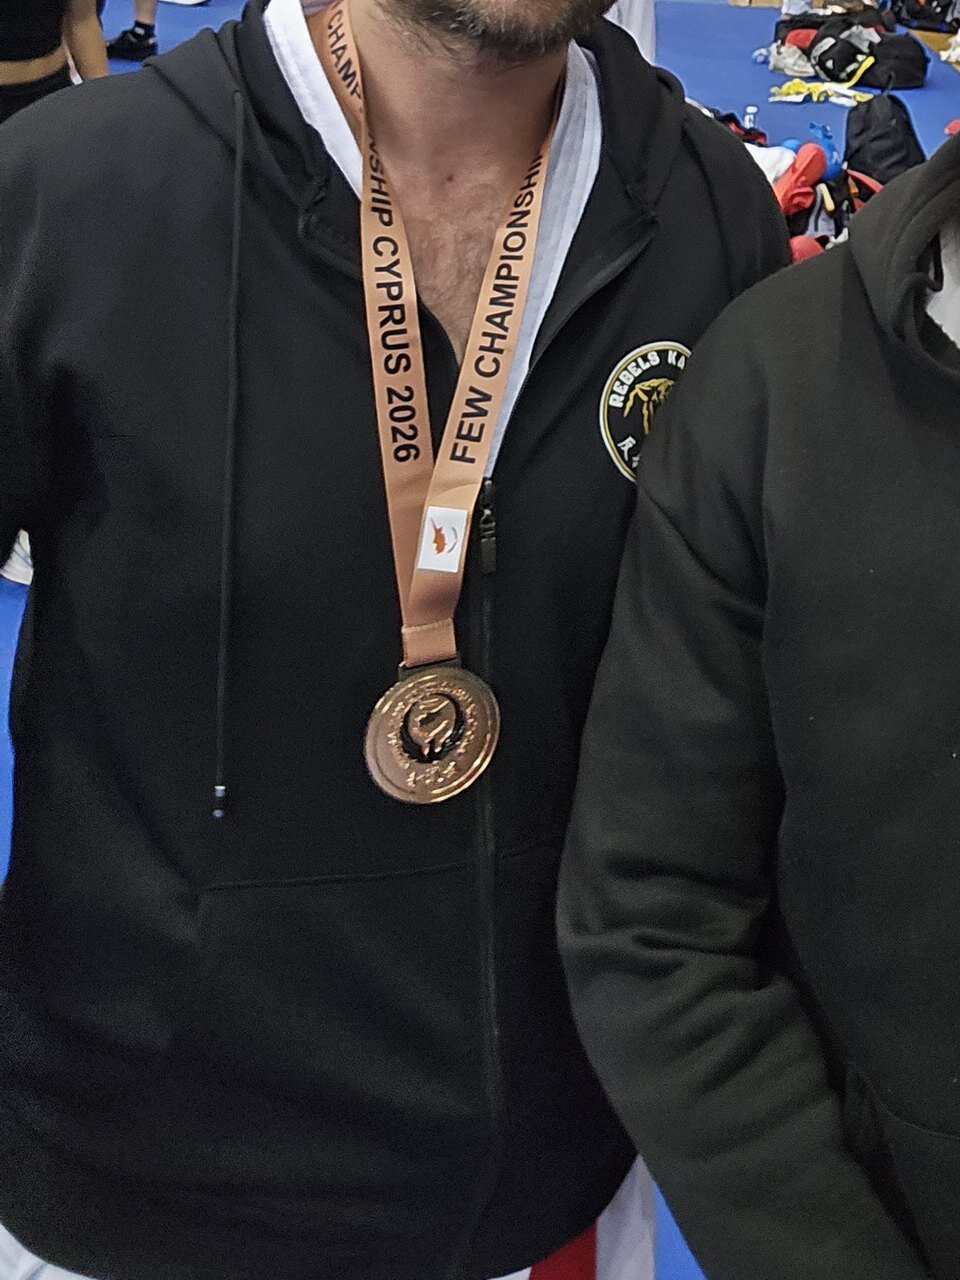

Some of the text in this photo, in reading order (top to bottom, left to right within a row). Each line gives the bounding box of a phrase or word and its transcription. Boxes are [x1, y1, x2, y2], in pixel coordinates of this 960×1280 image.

[372, 235, 412, 376] CYPRUS
[608, 350, 661, 409] REBELS
[385, 385, 421, 463] 2026
[448, 385, 493, 465] FEW
